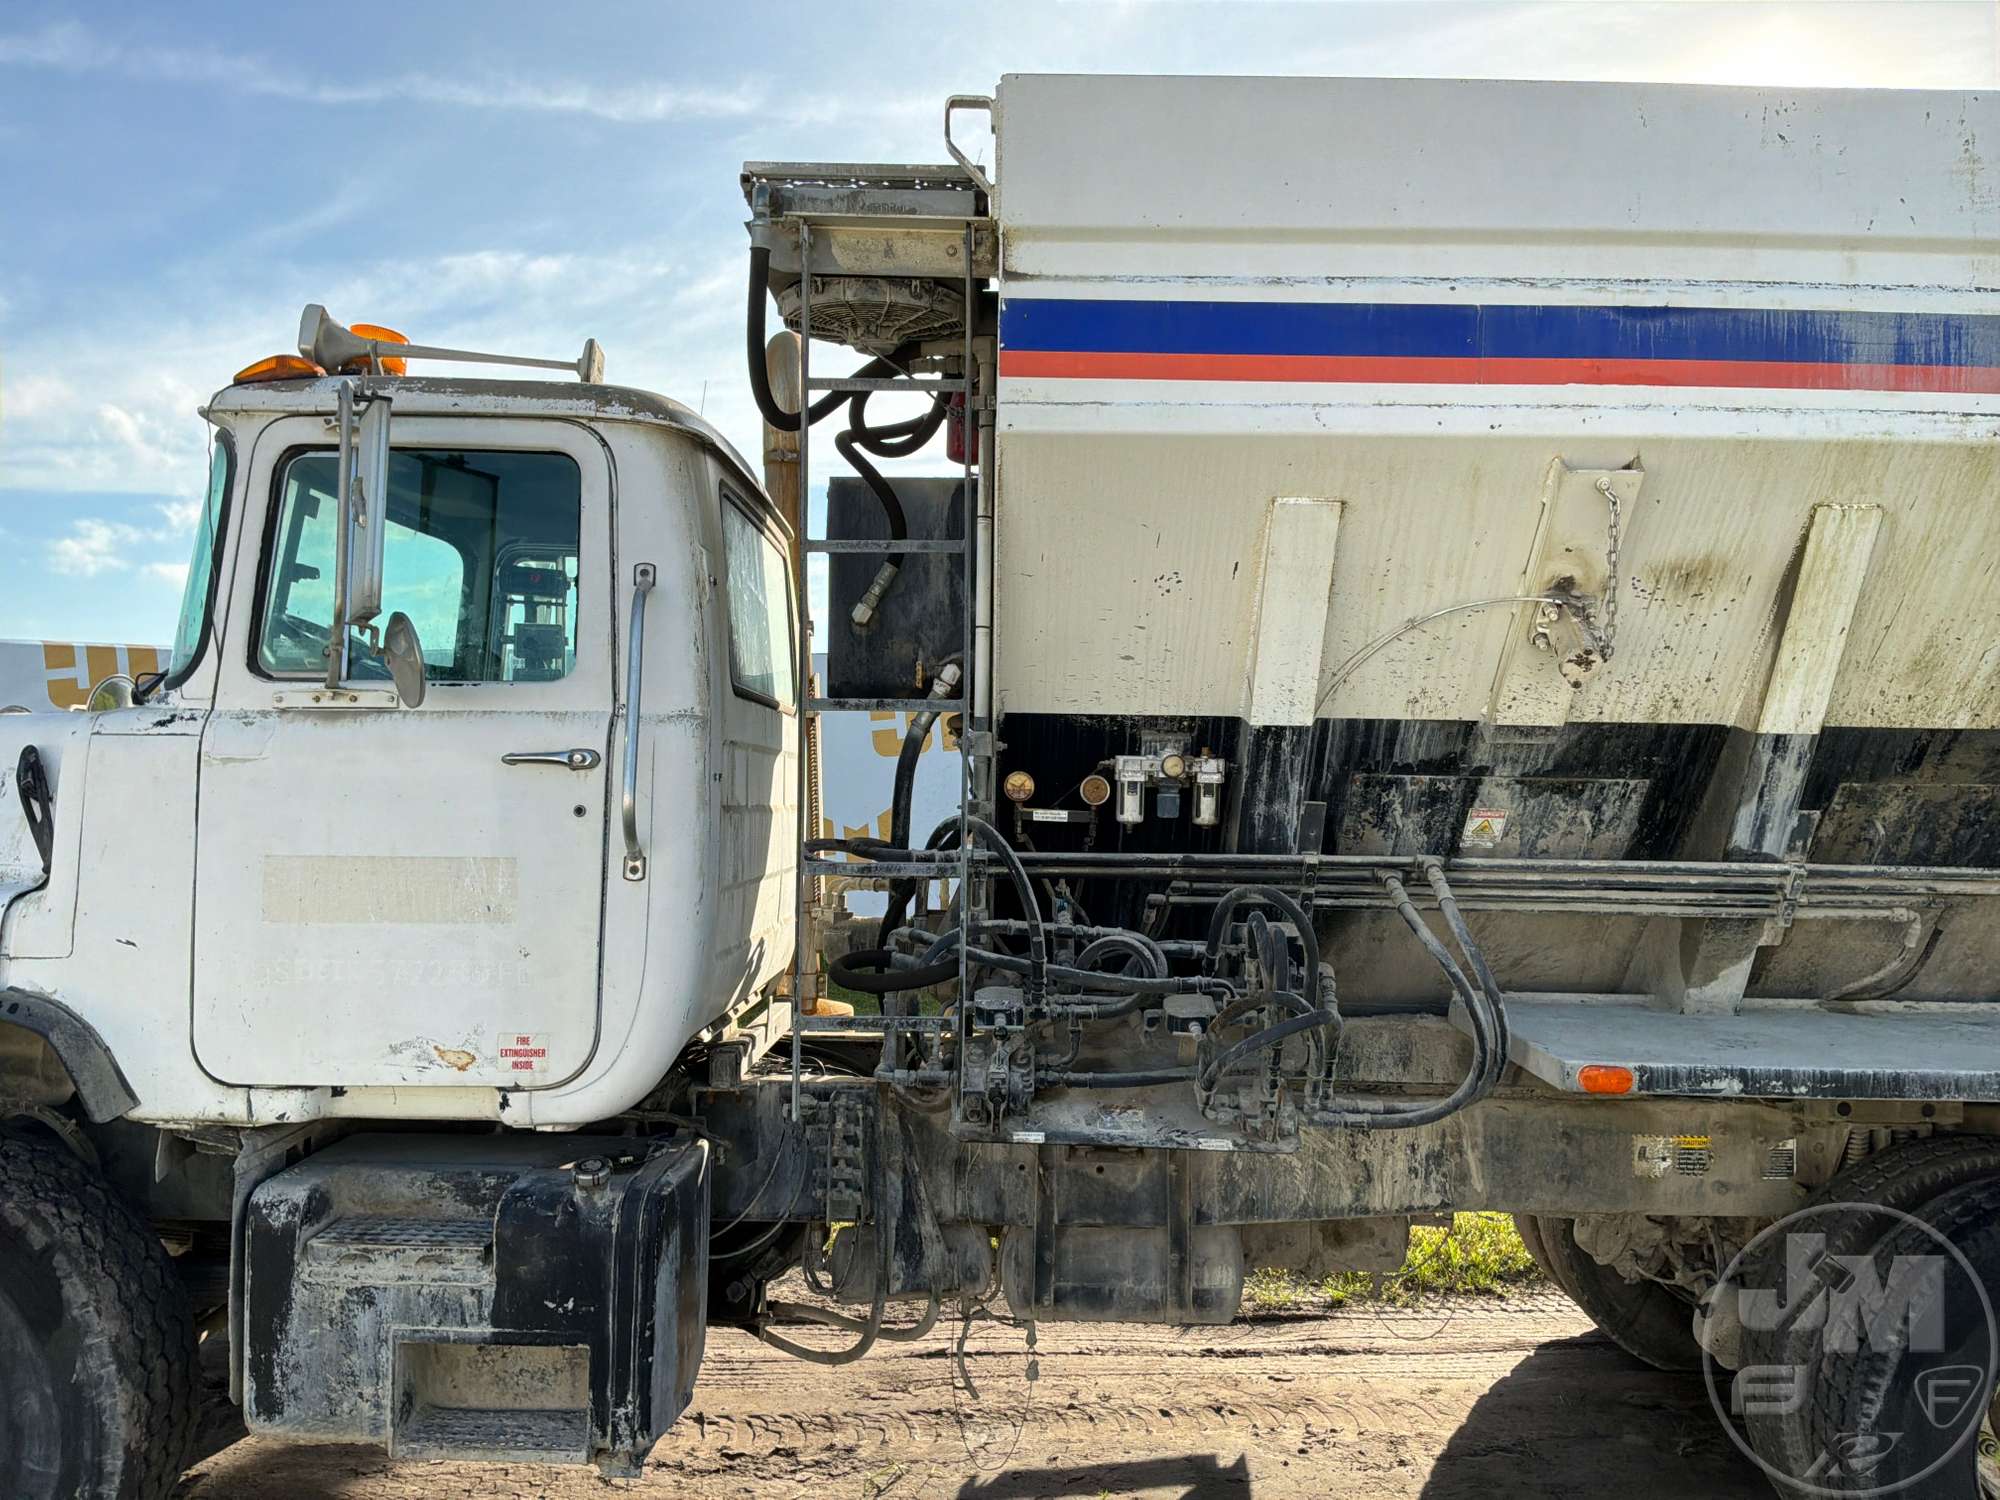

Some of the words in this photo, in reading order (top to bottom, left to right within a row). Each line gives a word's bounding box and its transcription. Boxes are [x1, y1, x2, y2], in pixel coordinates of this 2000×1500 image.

[516, 1036, 530, 1046] FIRE
[500, 1048, 546, 1058] EXTINGUISHER
[511, 1060, 534, 1070] INSIDE
